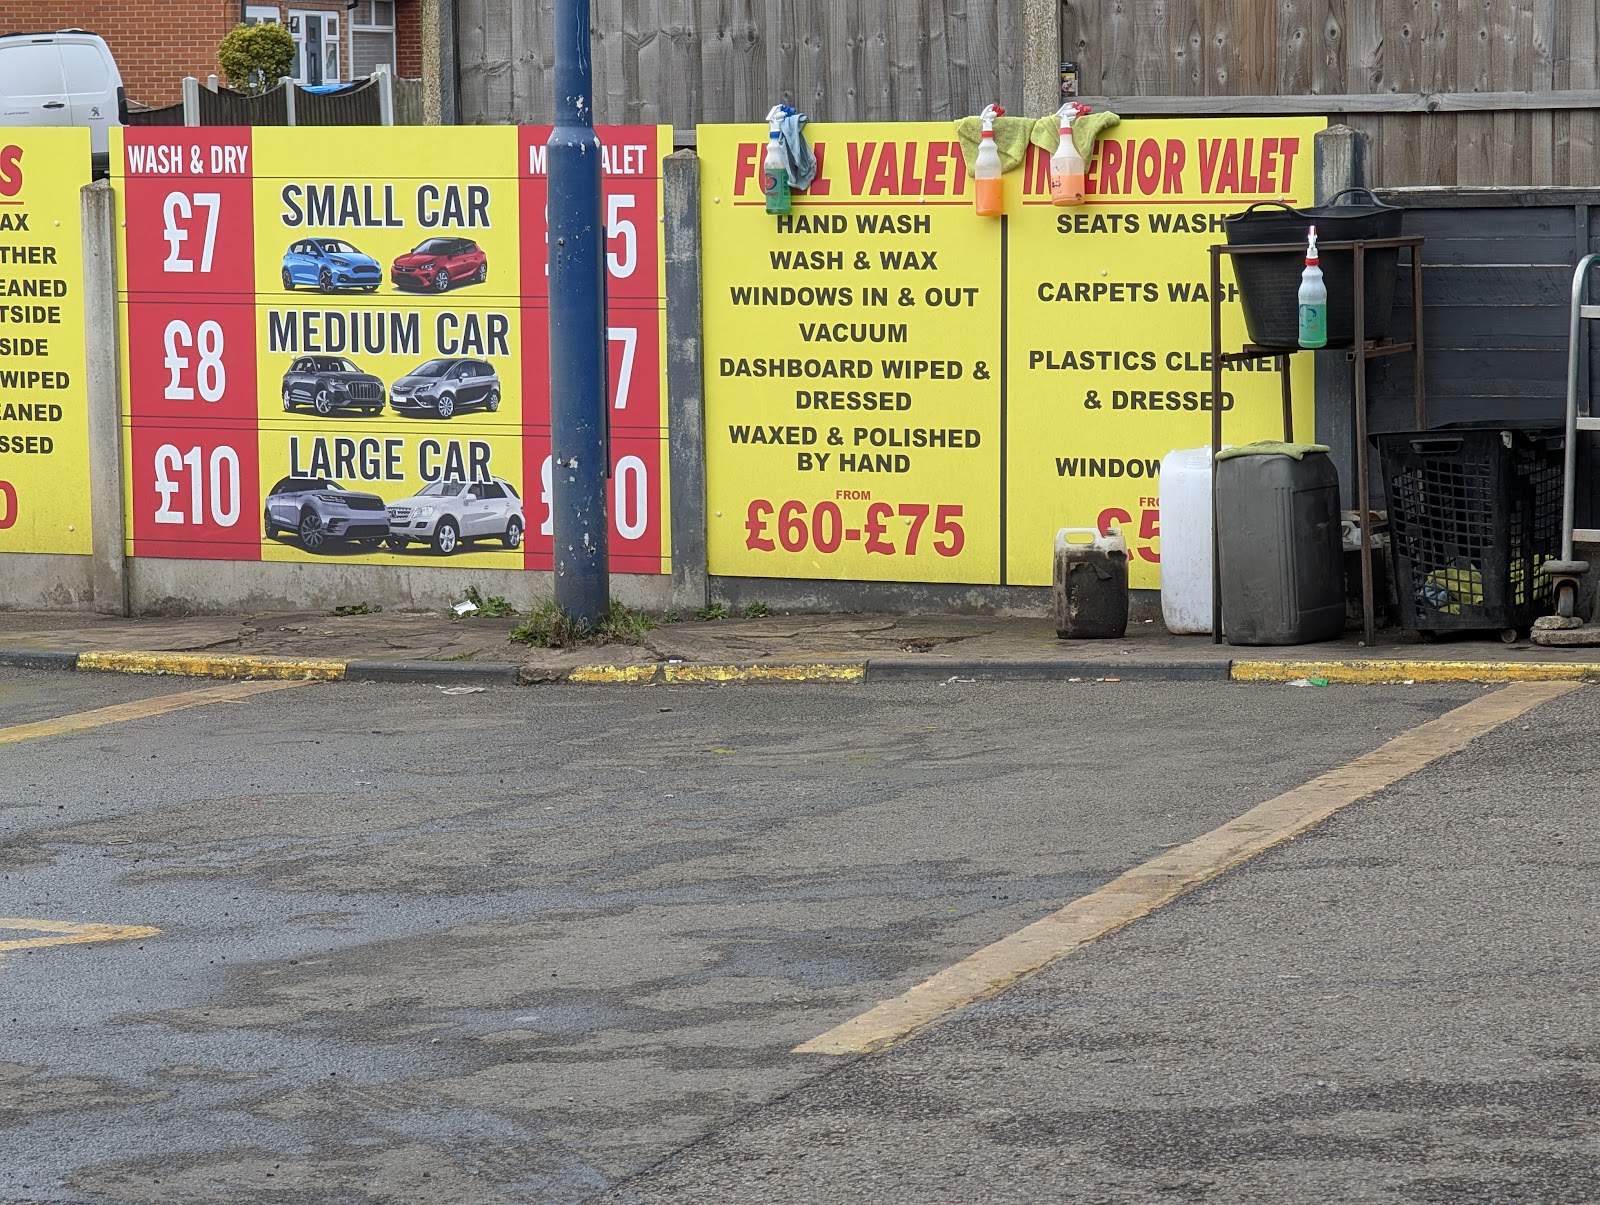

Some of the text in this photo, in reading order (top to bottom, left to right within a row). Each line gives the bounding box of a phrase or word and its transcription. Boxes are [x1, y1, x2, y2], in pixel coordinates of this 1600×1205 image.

[127, 145, 249, 174] WASH & DRY
[601, 145, 648, 175] ALET
[846, 141, 967, 196] VALET
[1197, 137, 1300, 194] VALET
[281, 183, 491, 229] SMALL CAR
[162, 191, 221, 273] £7
[776, 214, 931, 234] HAND WASH
[1056, 213, 1235, 234] SEATS WASH
[769, 250, 938, 270] WASH & WAX
[730, 286, 980, 307] WINDOWS IN & OUT
[1037, 282, 1159, 302] CARPETS
[268, 310, 510, 356] MEDIUM CAR
[798, 323, 908, 343] VACUUM
[163, 319, 227, 402] £8
[719, 358, 991, 381] DASHBOARD WIPED &
[1029, 350, 1156, 371] PLASTICS
[0, 370, 70, 390] WIPED
[796, 390, 912, 411] DRESSED
[1083, 390, 1235, 411] & DRESSED
[728, 425, 982, 448] WAXED & POLISHED
[289, 436, 493, 485] LARGE CAR
[797, 452, 911, 473] BY HAND
[154, 443, 242, 527] £10
[835, 490, 871, 501] FROM
[744, 498, 965, 557] £60-£75
